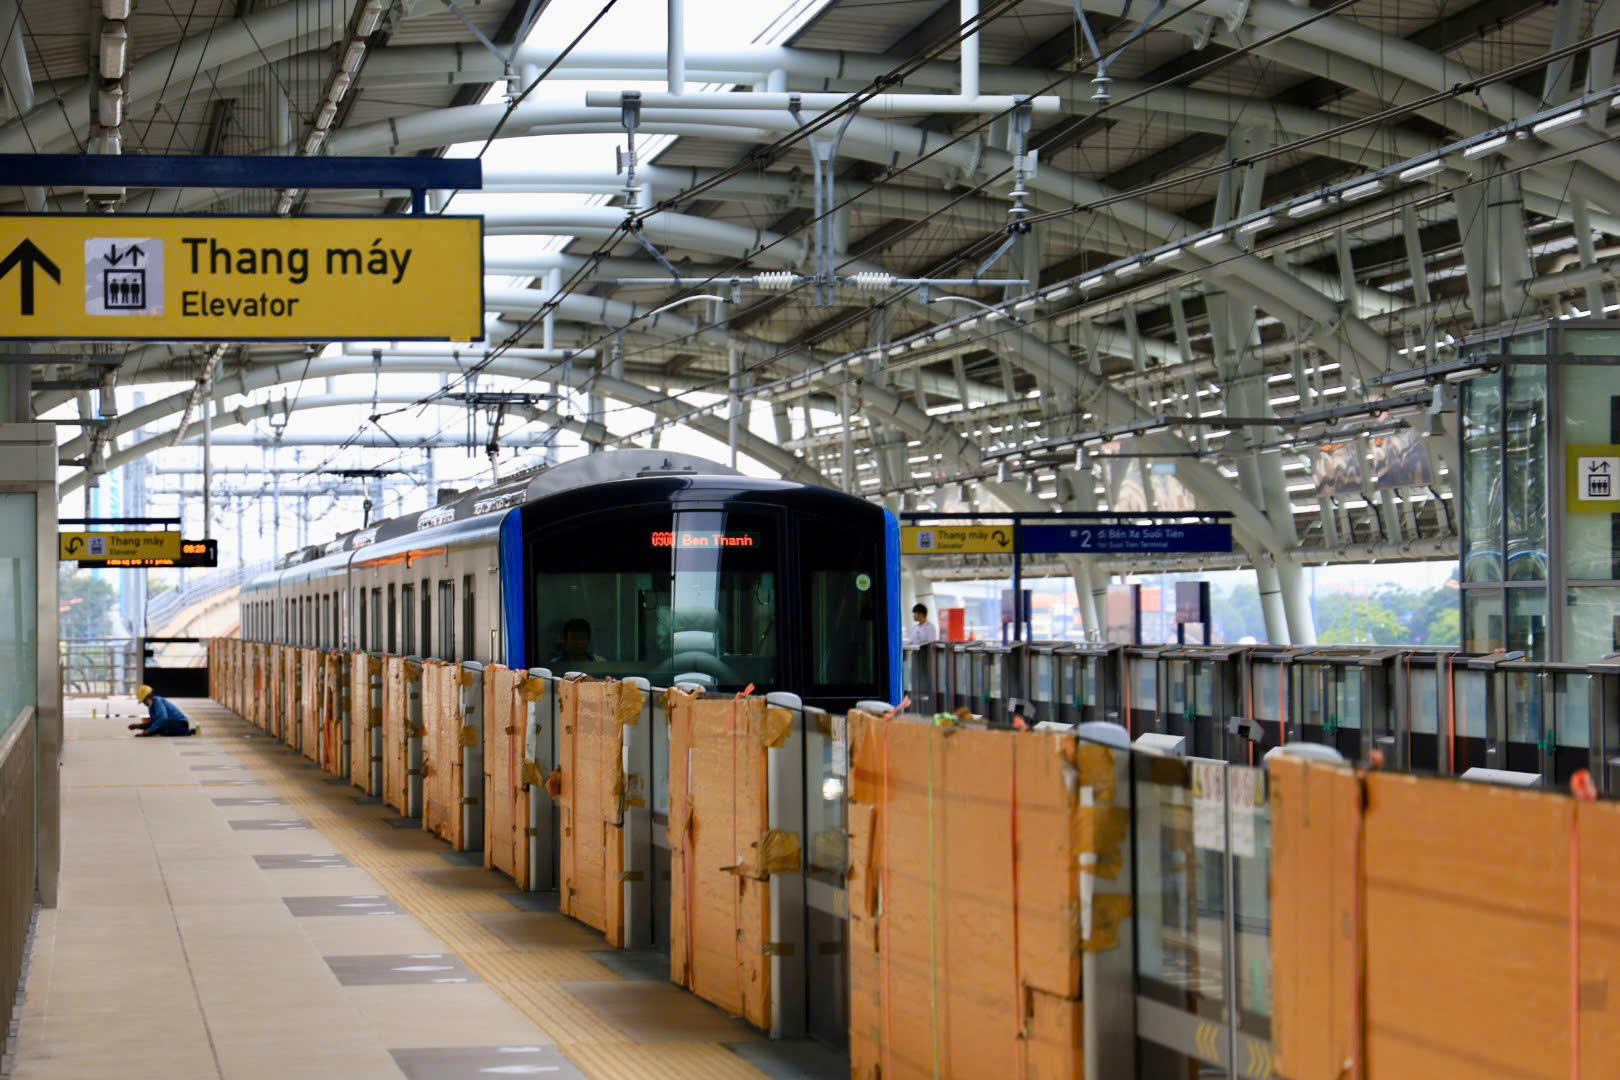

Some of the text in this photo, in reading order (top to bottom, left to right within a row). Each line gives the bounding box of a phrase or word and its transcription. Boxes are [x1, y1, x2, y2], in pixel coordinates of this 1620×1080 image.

[182, 237, 412, 285] Thang máy
[182, 290, 300, 317] Elevator
[111, 536, 165, 546] Thang máy
[682, 534, 708, 546] Ben
[711, 533, 753, 546] Thanh
[938, 530, 966, 541] Thang
[1080, 529, 1092, 548] 2
